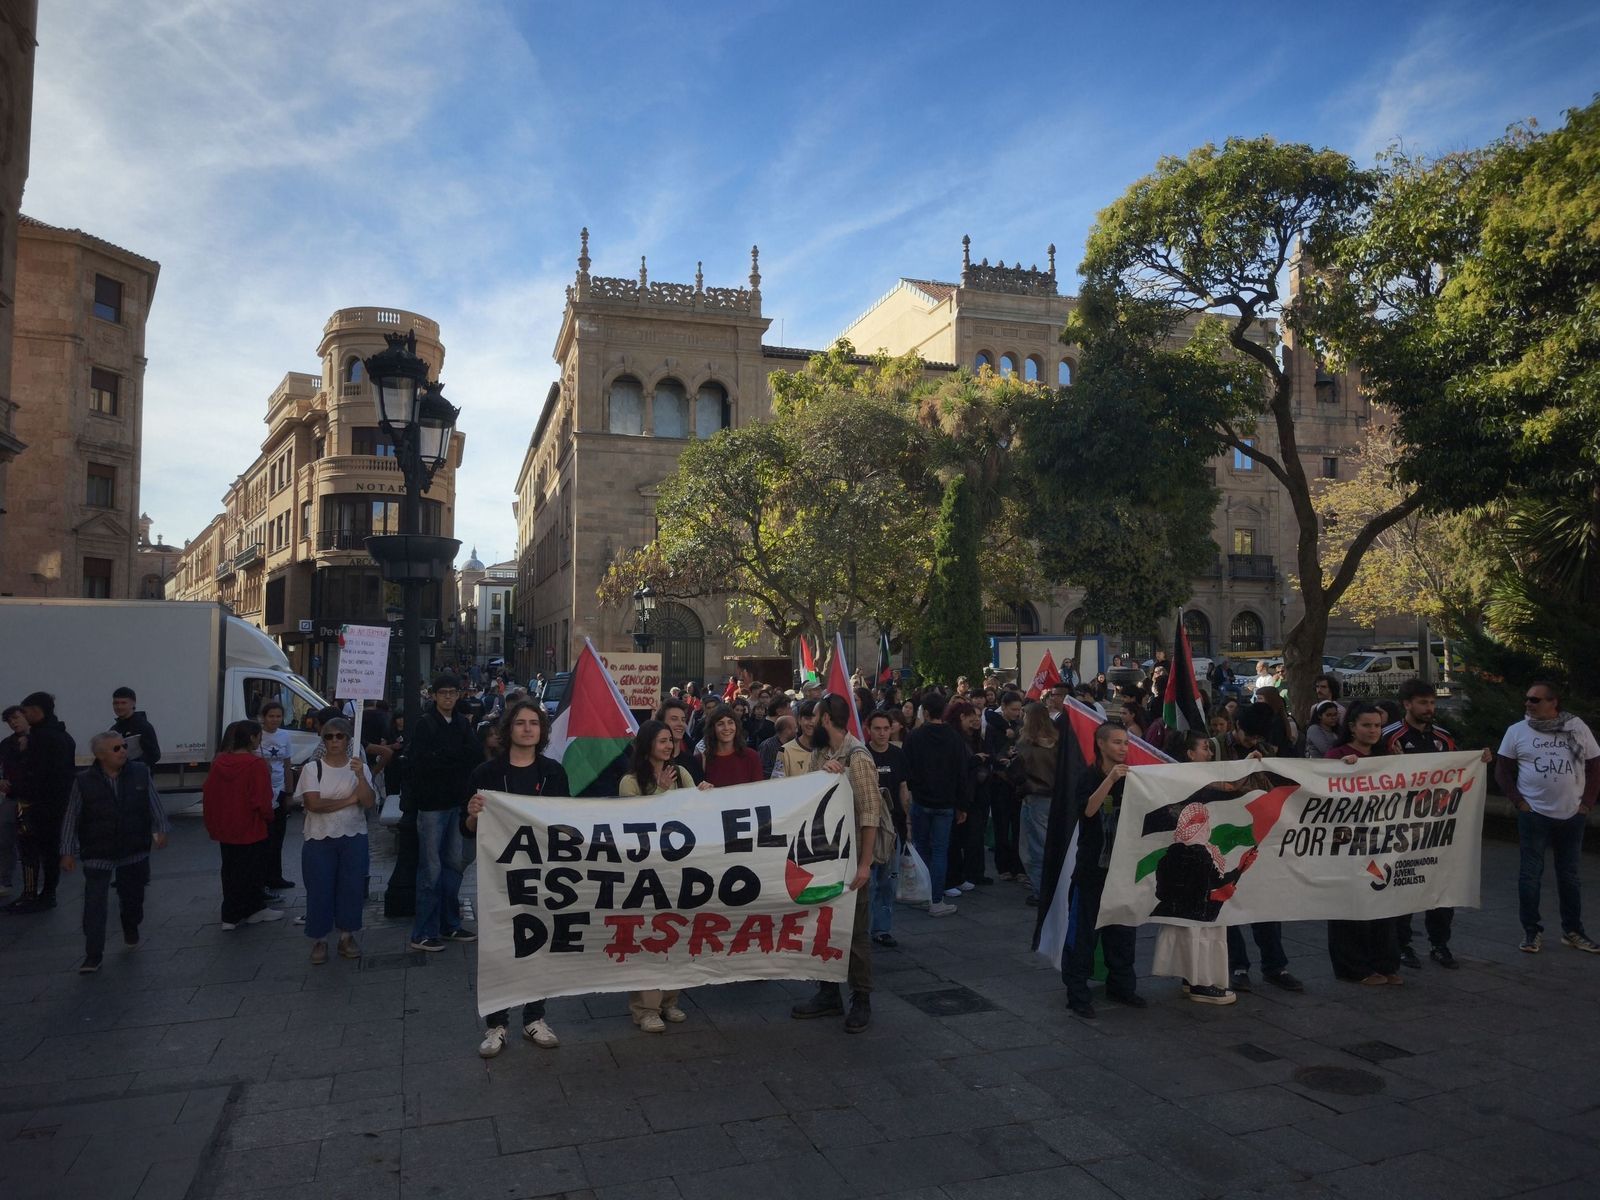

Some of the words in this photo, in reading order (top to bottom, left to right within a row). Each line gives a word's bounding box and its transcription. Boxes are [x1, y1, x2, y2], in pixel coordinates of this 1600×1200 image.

[1328, 773, 1406, 793] HUELGA
[1410, 772, 1426, 788] 15
[1429, 768, 1466, 785] OCT
[1534, 757, 1573, 774] GAZA
[1299, 793, 1402, 824] PARARLO
[1402, 787, 1463, 819] TODO
[496, 821, 696, 864] ABAJO
[721, 805, 788, 854] EL
[1278, 827, 1326, 857] POR
[1329, 818, 1457, 856] PALESTINA
[1393, 868, 1416, 878] JUVENIL
[1395, 857, 1438, 869] COORDINADORA
[506, 865, 761, 909] ESTADO
[1393, 875, 1426, 887] SOCIALISTA
[512, 911, 590, 957] DE
[603, 906, 843, 962] ISRAEL
